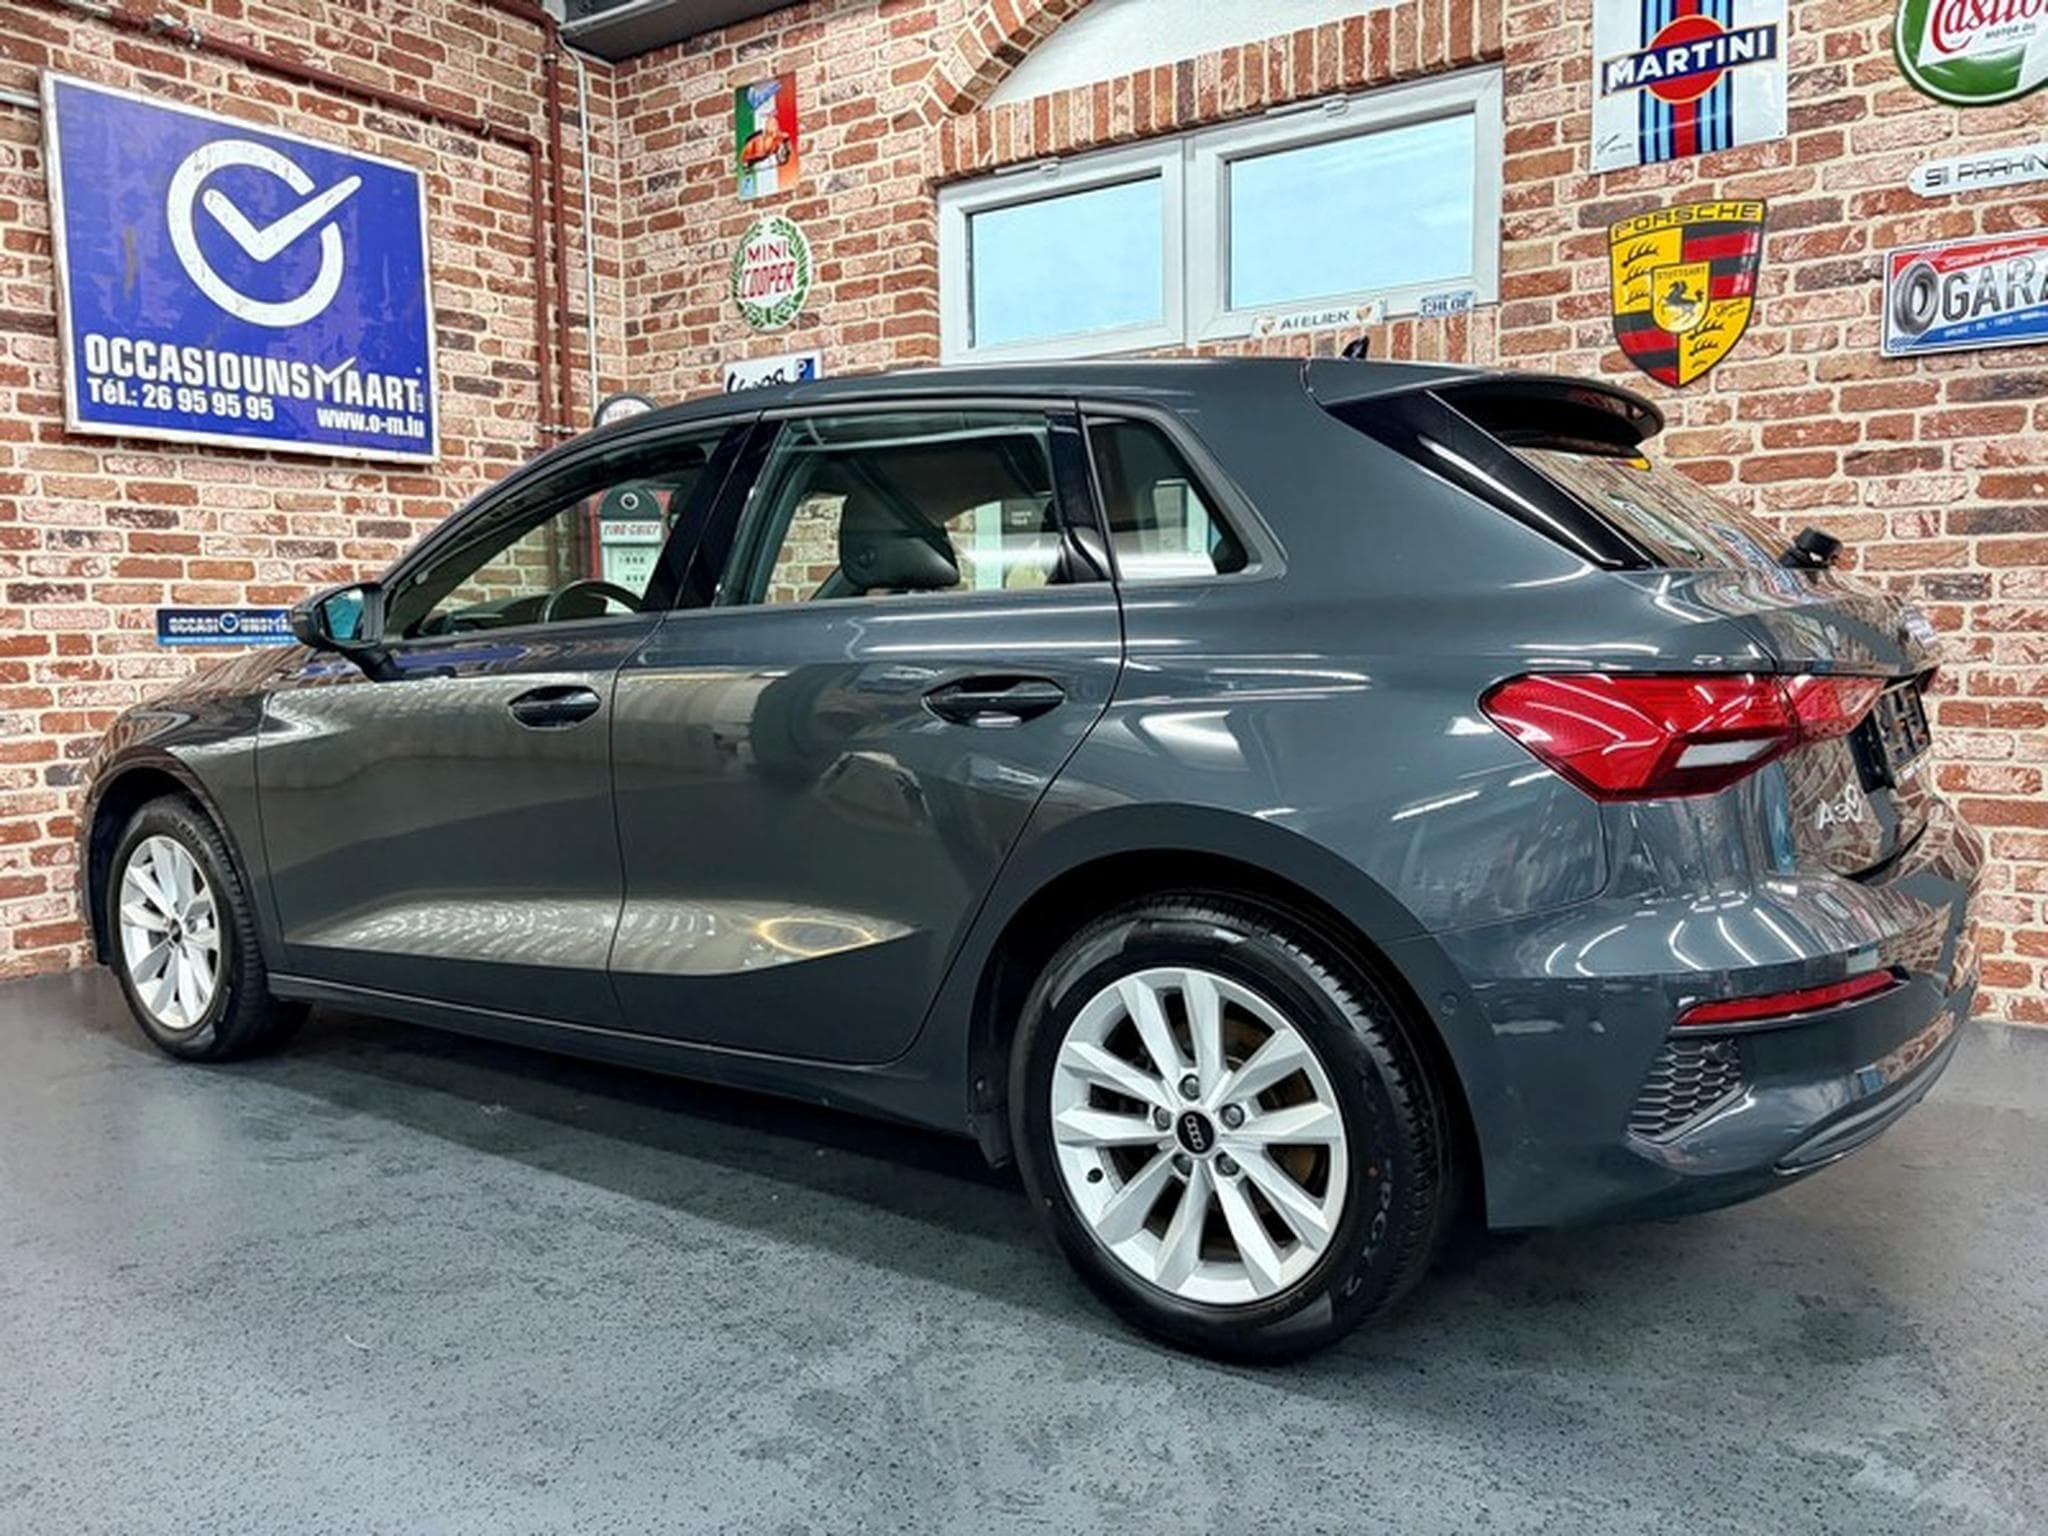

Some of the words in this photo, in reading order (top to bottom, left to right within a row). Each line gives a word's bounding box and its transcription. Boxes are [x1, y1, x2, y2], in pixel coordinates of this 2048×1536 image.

[1607, 30, 1768, 89] MARTINI
[1615, 203, 1760, 238] PORSCHE
[747, 241, 787, 261] MINI
[742, 261, 796, 299] COOPER
[1943, 256, 2048, 322] GAR
[1280, 310, 1350, 331] ATELIER
[142, 383, 172, 410] 26
[177, 386, 208, 414] 95
[212, 389, 242, 418] 95
[246, 393, 275, 422] 95
[317, 408, 425, 438] www.o-m.lu
